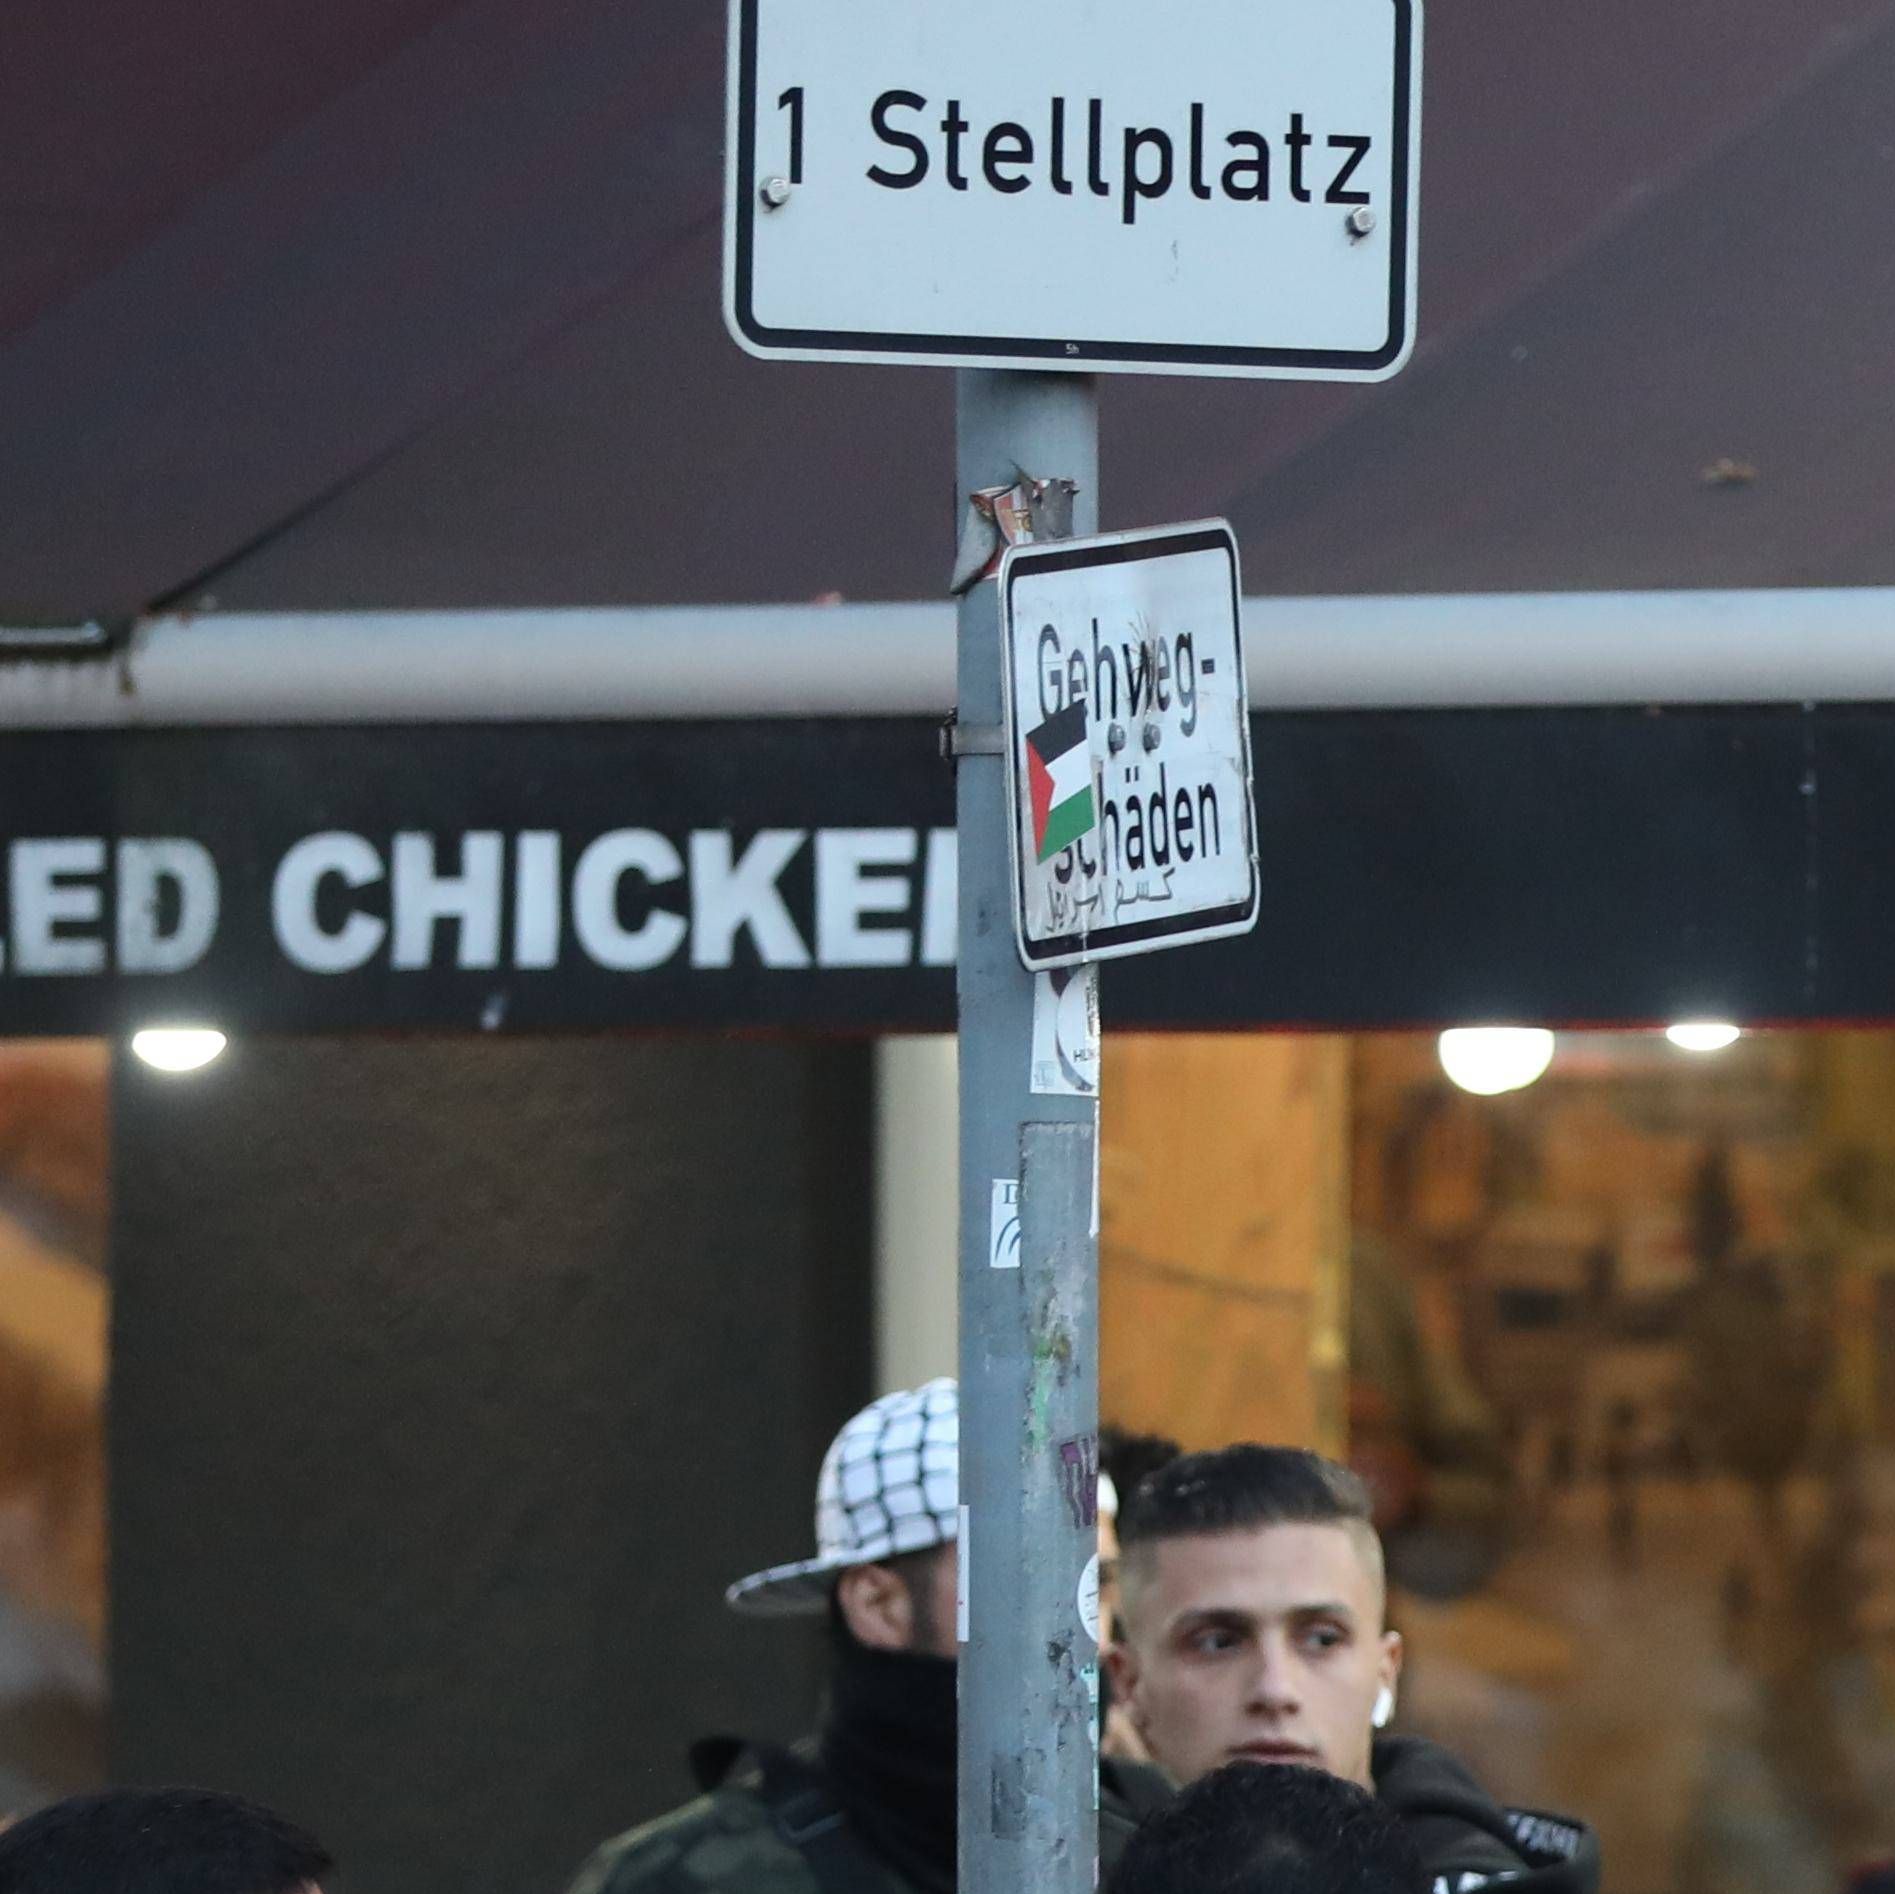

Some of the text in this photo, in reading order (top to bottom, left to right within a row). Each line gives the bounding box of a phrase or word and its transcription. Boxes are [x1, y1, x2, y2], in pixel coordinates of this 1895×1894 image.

[777, 86, 1372, 225] 1 Stellplatz
[1037, 616, 1216, 737] Gehweg-
[0, 835, 221, 977] ED
